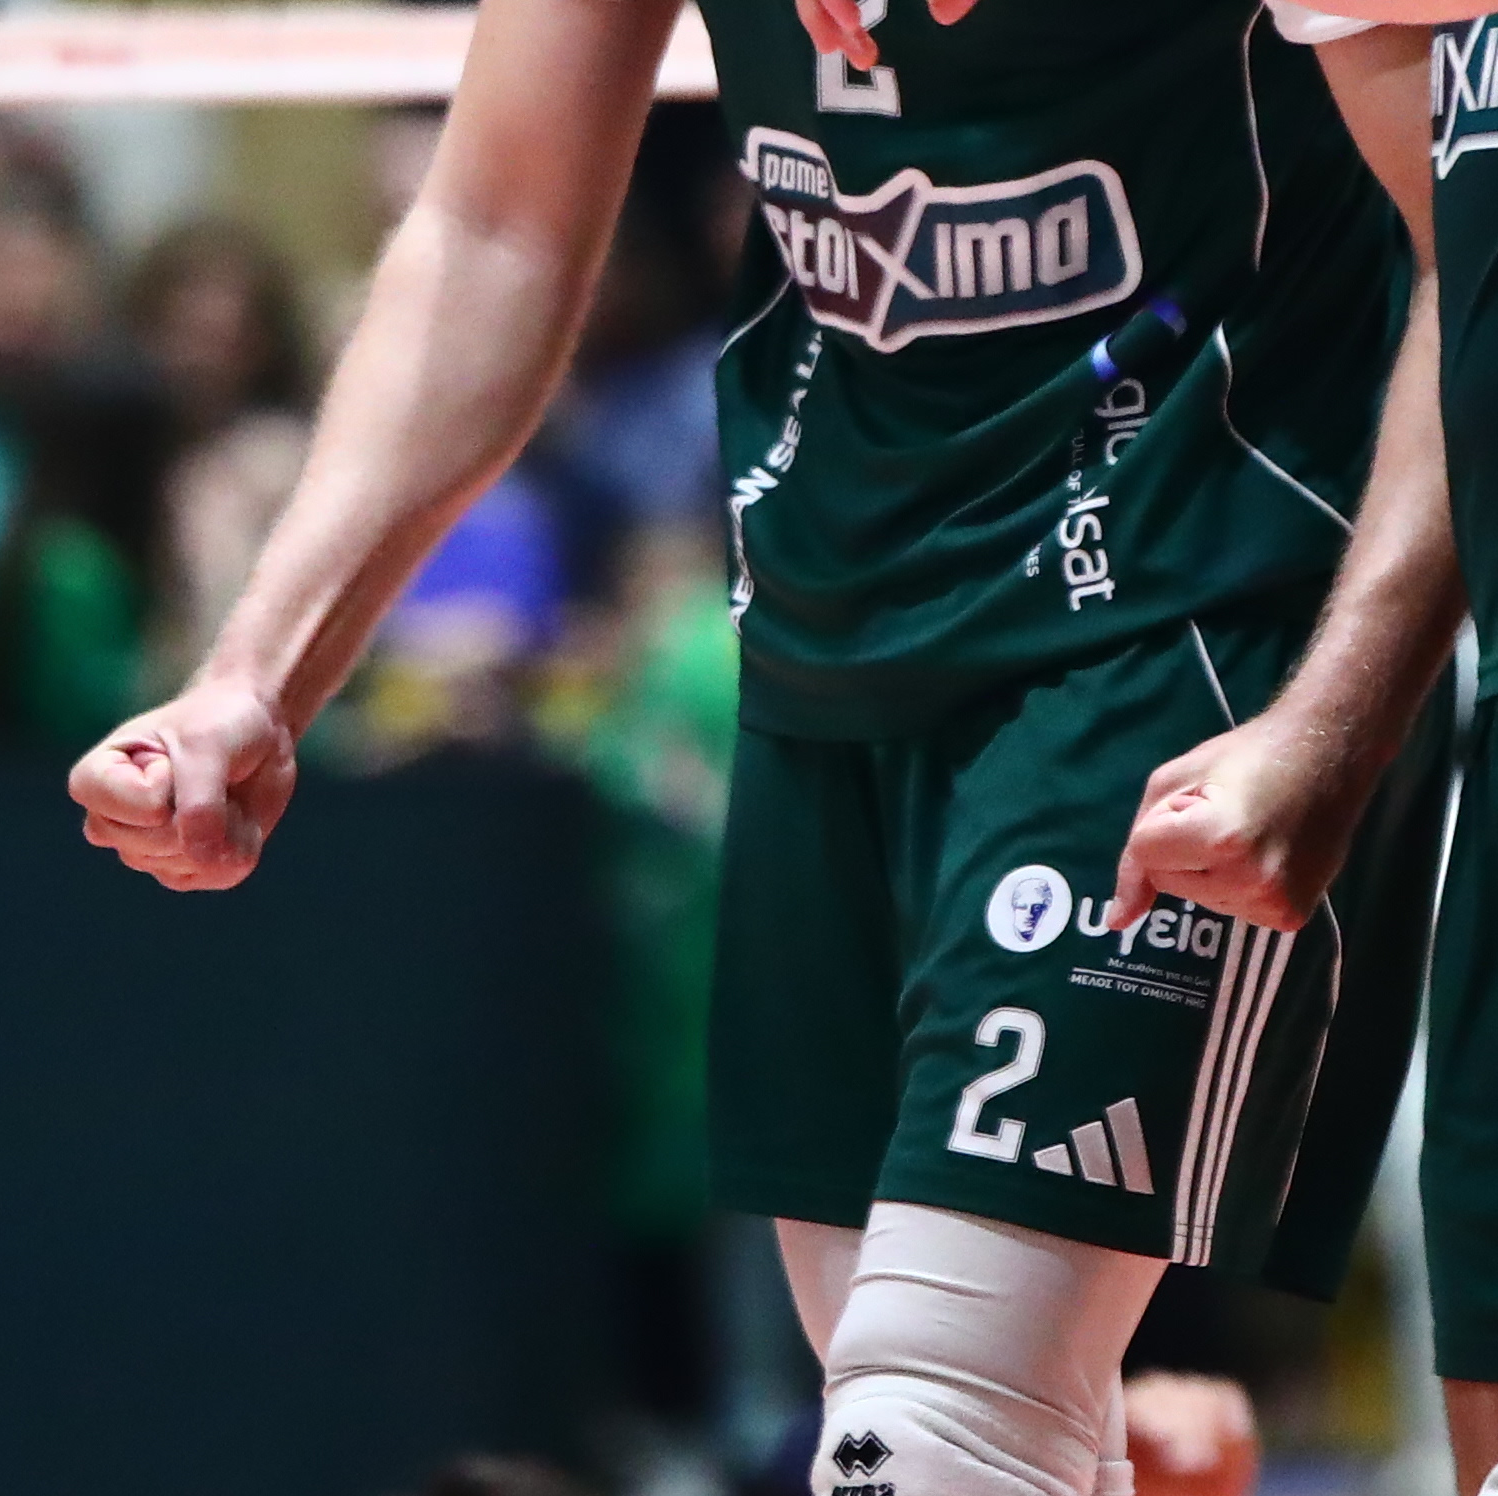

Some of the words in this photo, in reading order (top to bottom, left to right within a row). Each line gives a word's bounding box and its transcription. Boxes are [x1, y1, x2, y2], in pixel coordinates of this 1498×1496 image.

[765, 153, 830, 199] pame
[1069, 973, 1114, 989] ΜΕΛΟΣ
[1116, 981, 1138, 994] ΤΟΥ
[946, 1006, 1046, 1163] 2
